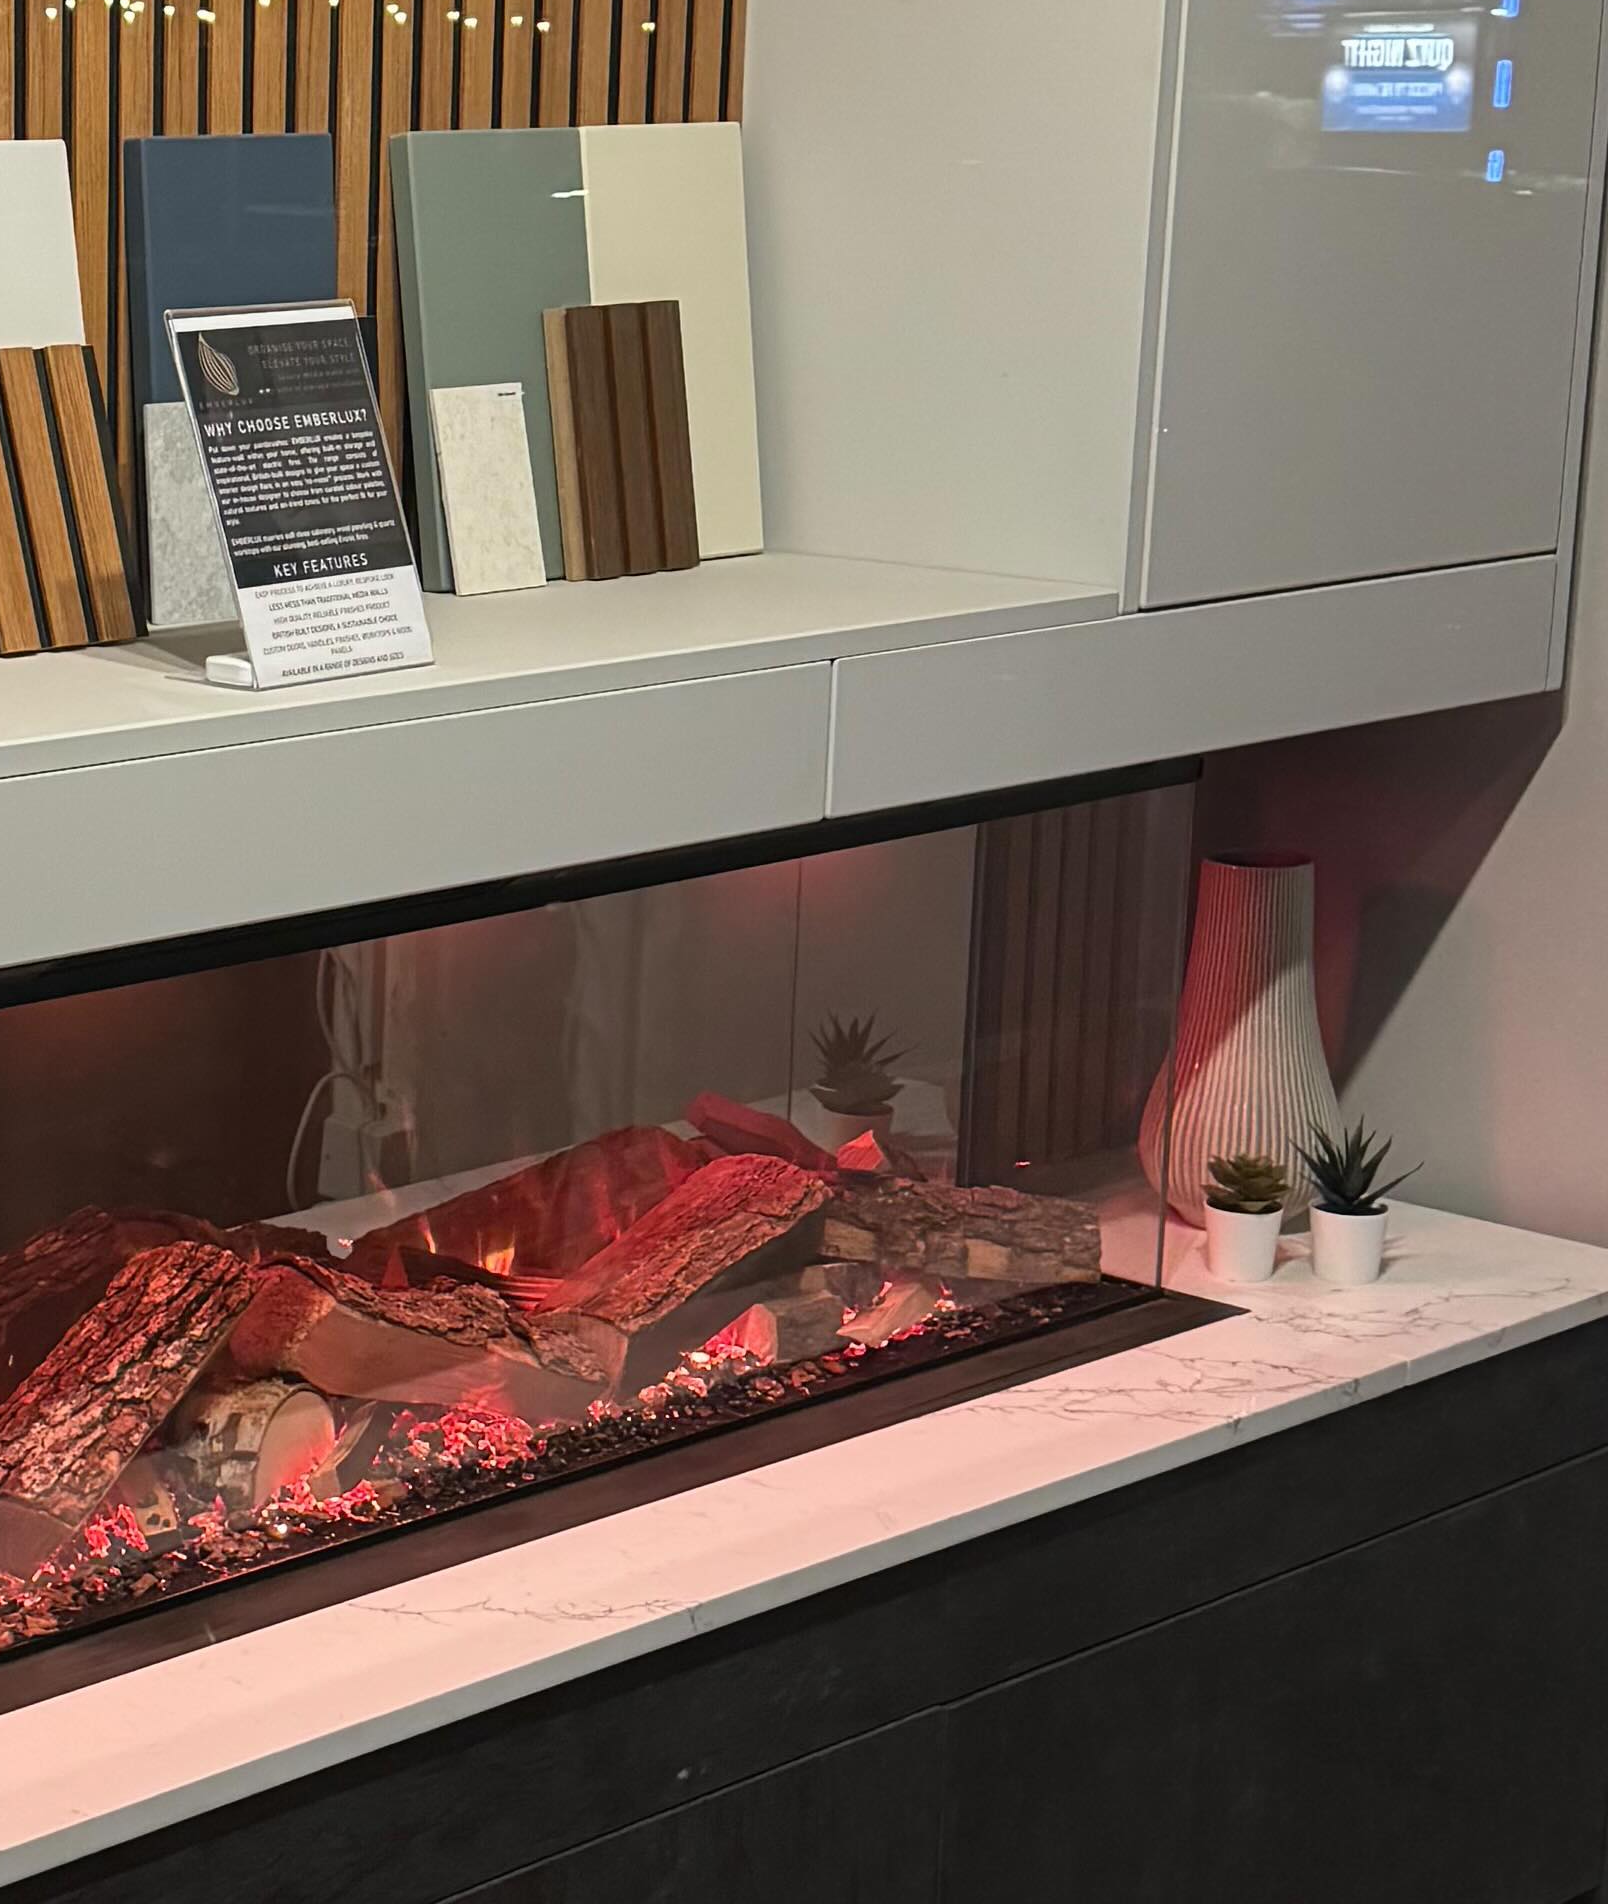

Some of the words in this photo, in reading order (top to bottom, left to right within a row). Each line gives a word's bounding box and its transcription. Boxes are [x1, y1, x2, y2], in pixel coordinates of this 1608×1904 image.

[202, 421, 234, 437] WHY
[236, 415, 290, 434] CHOOSE
[293, 408, 369, 428] EMBERLUX?
[272, 561, 299, 578] KEY
[301, 552, 369, 573] FEATURES
